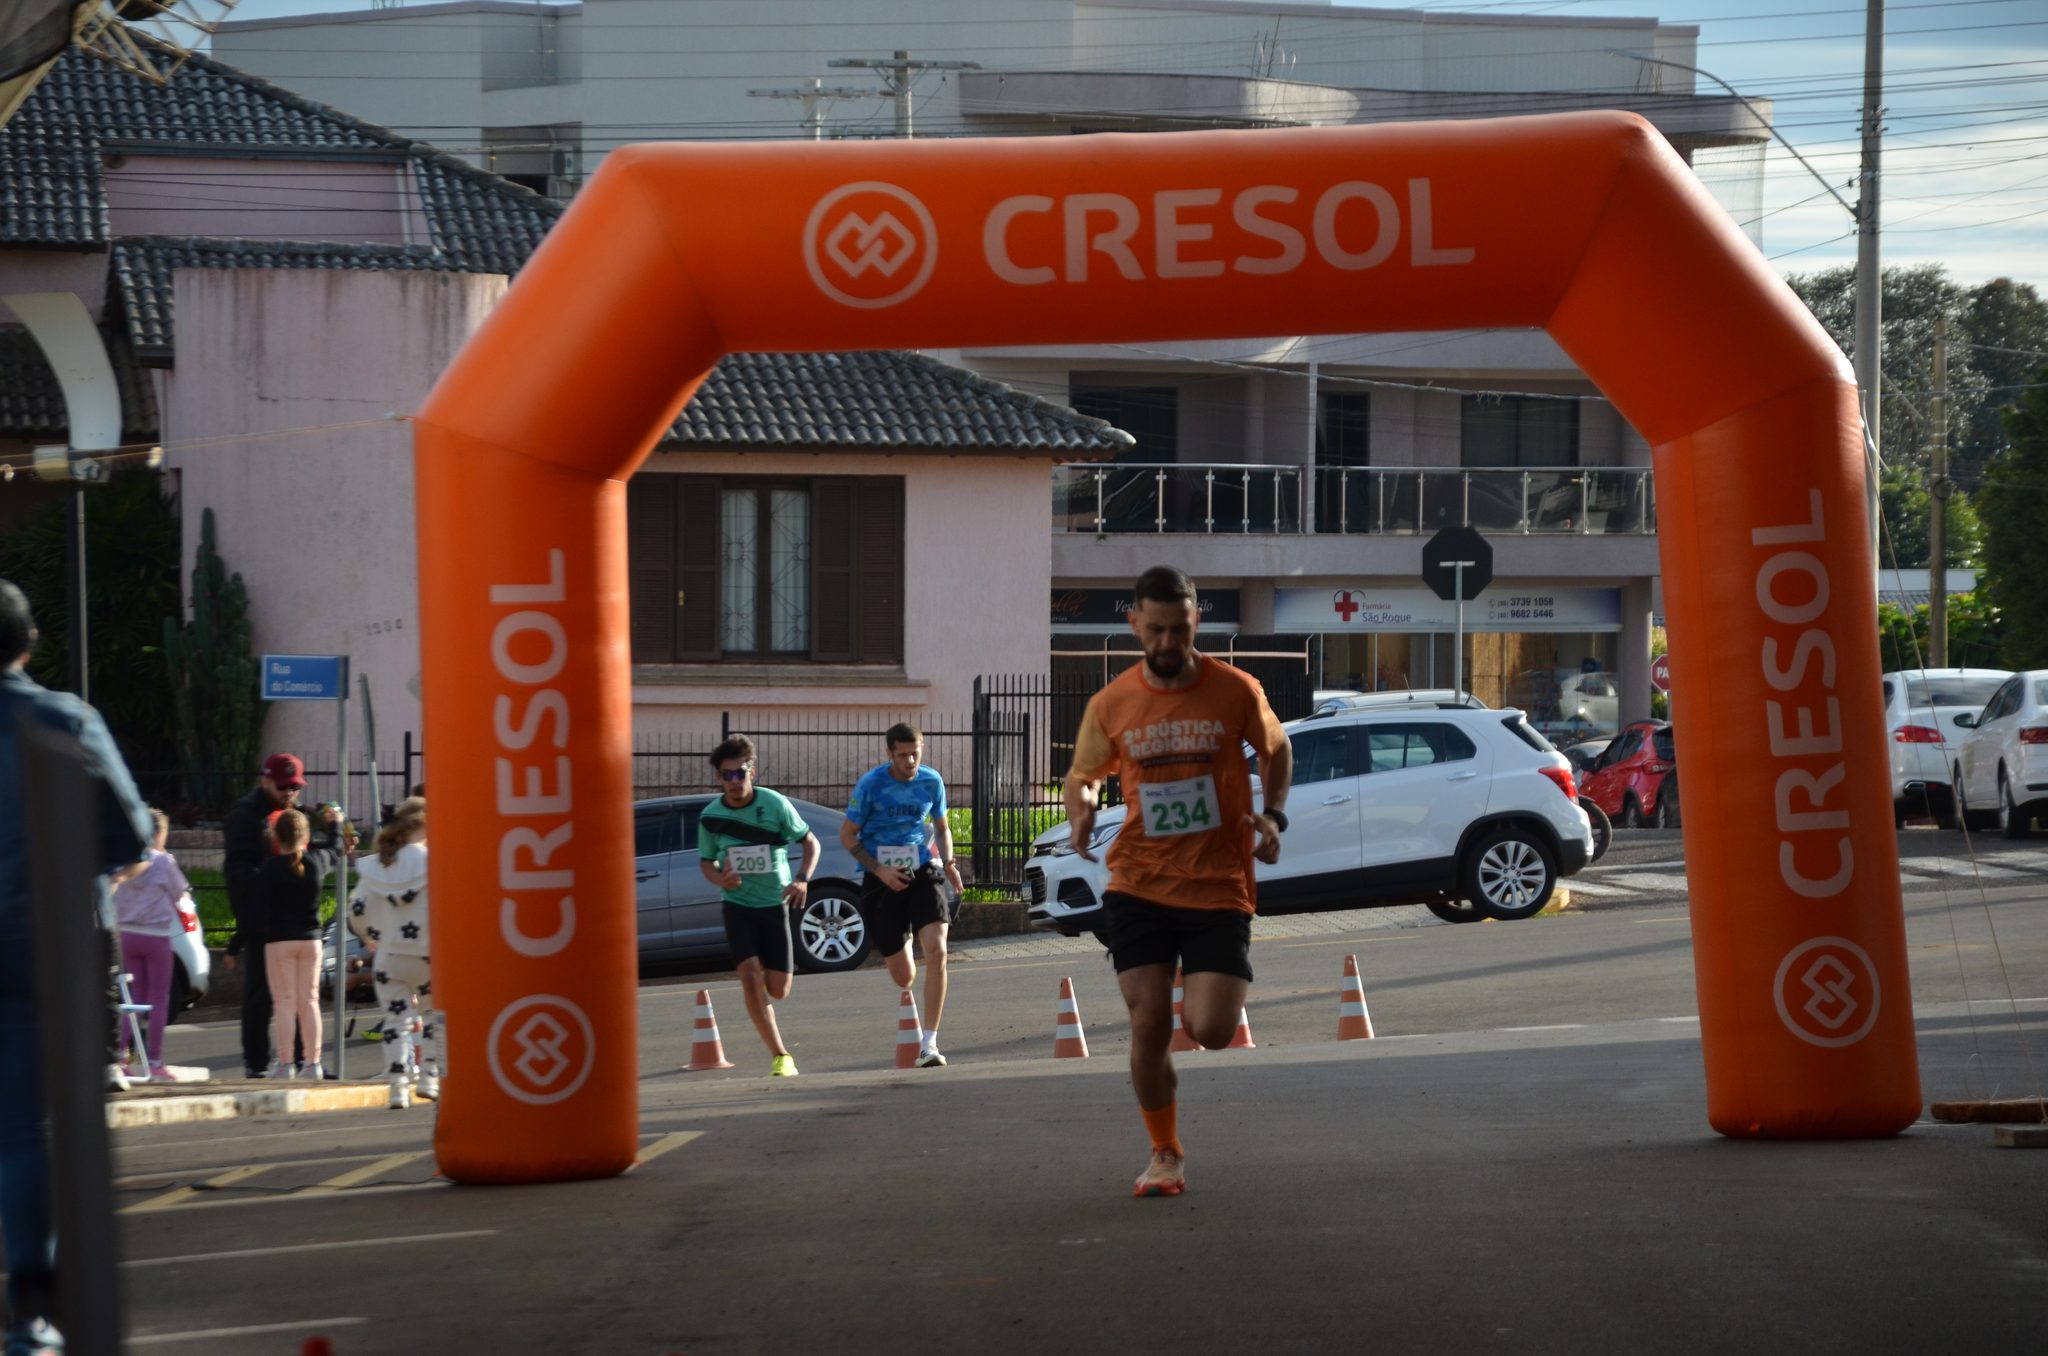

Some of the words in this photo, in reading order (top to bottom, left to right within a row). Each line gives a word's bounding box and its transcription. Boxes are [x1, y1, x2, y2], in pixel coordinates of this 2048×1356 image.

[982, 178, 1475, 285] CRESOL
[1510, 597, 1531, 606] 3739
[1362, 611, 1380, 623] São
[1383, 611, 1412, 624] Roque
[271, 662, 291, 674] Rua
[1657, 667, 1670, 679] PA
[271, 680, 283, 692] do
[1751, 488, 1854, 898] CRESOL
[1145, 718, 1225, 739] RÚSTICA
[489, 548, 576, 957] CRESOL
[1129, 734, 1220, 758] REGIONAL
[1151, 797, 1211, 831] 234
[735, 855, 766, 871] 209
